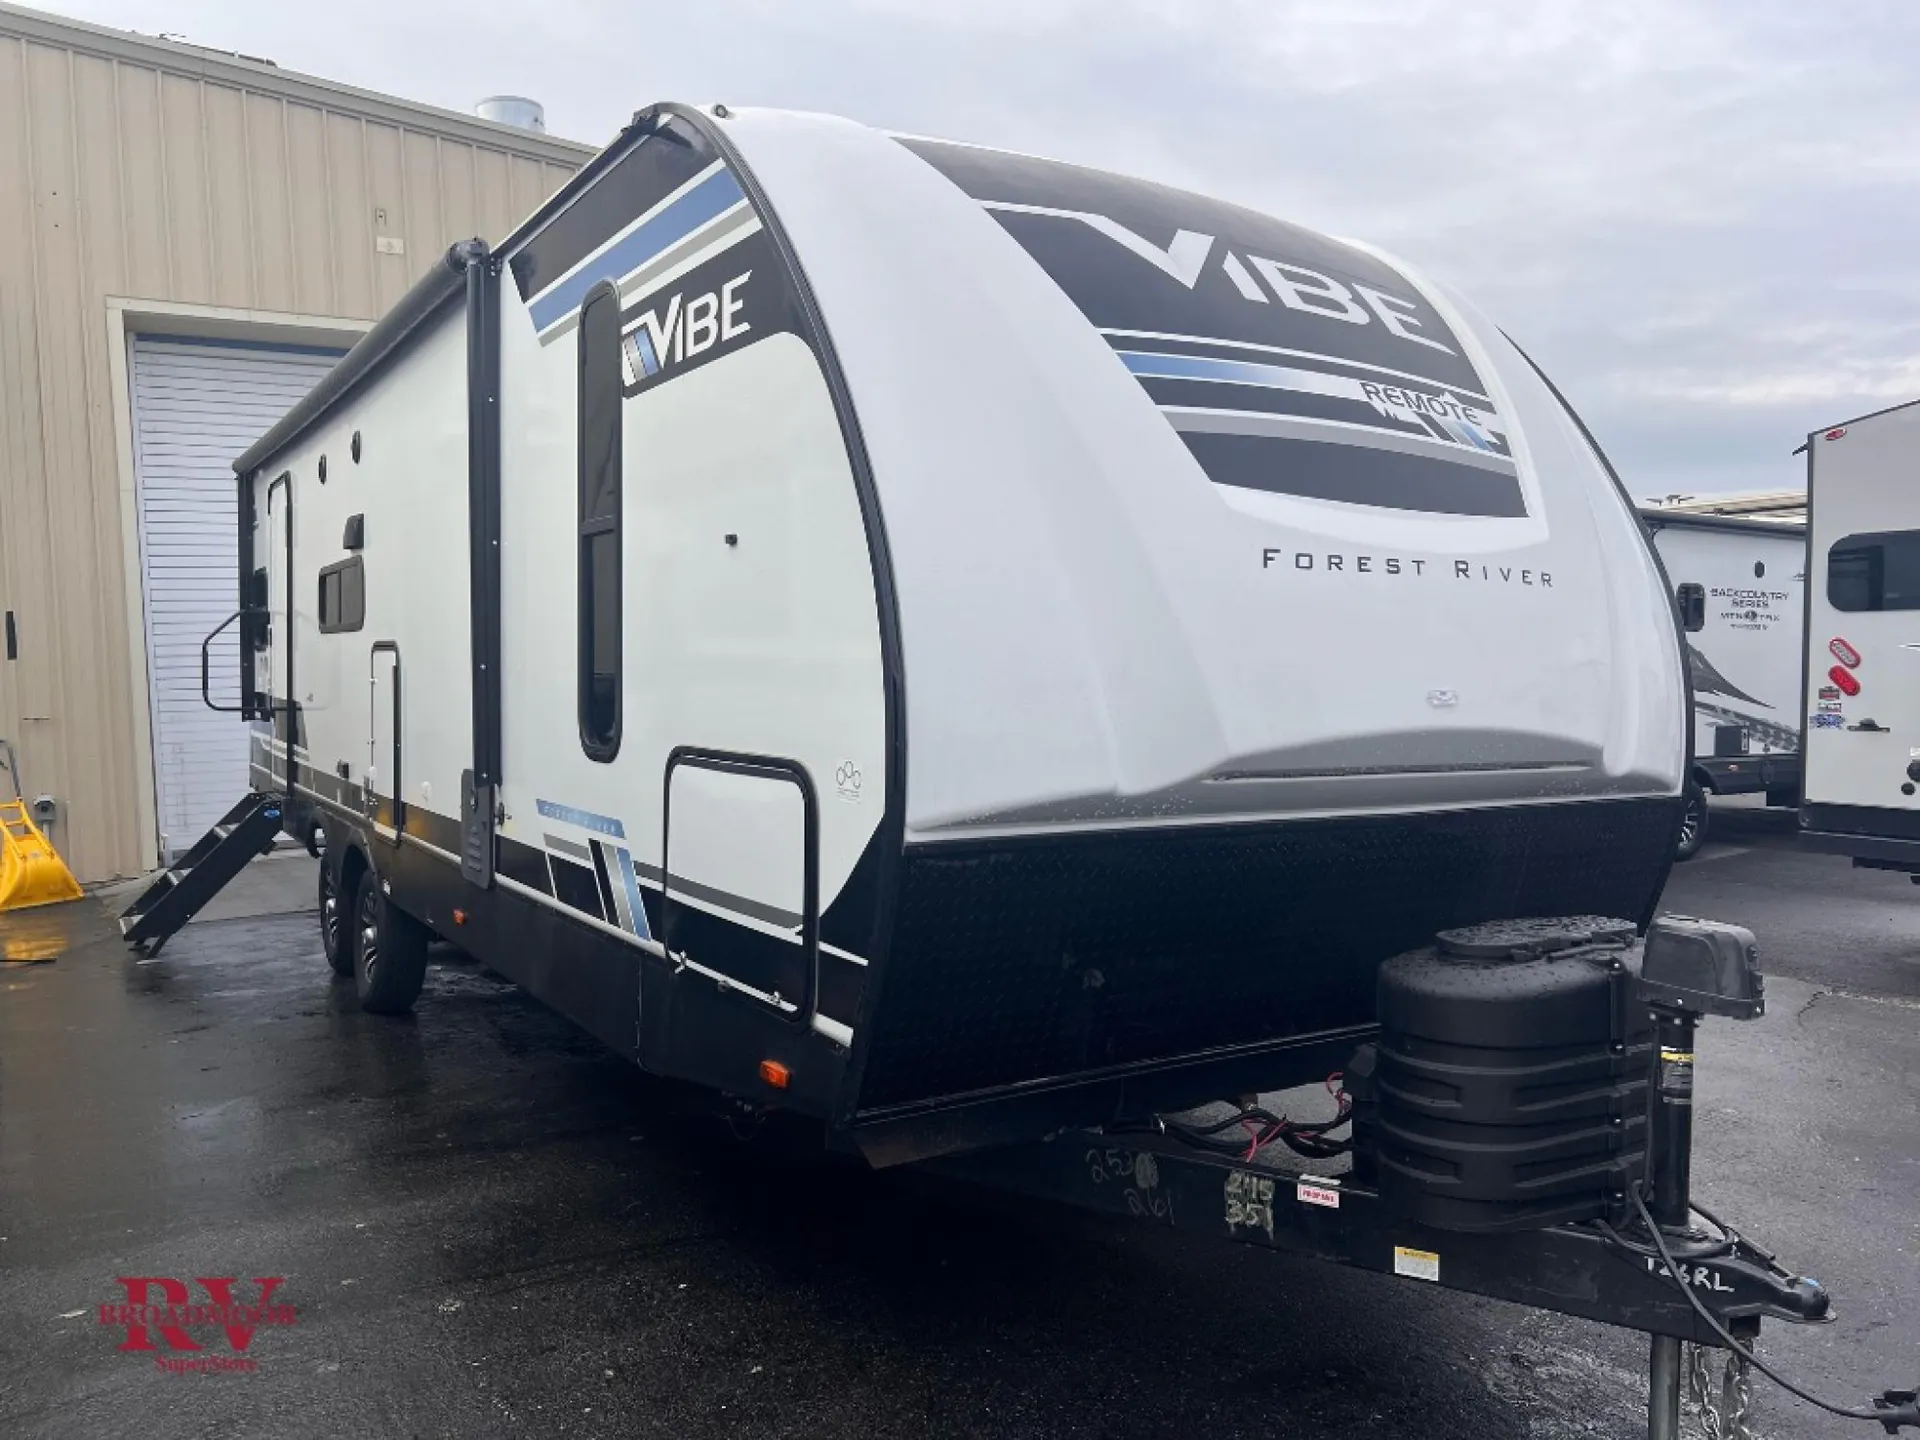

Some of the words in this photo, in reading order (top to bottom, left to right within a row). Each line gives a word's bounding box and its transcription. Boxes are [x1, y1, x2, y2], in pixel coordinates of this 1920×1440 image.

[1082, 215, 1457, 357] VIBE
[622, 269, 753, 372] VIBE
[1359, 382, 1482, 427] REMOTE
[1709, 587, 1790, 601] BACKCOUNTRY
[1732, 598, 1770, 609] SERIES
